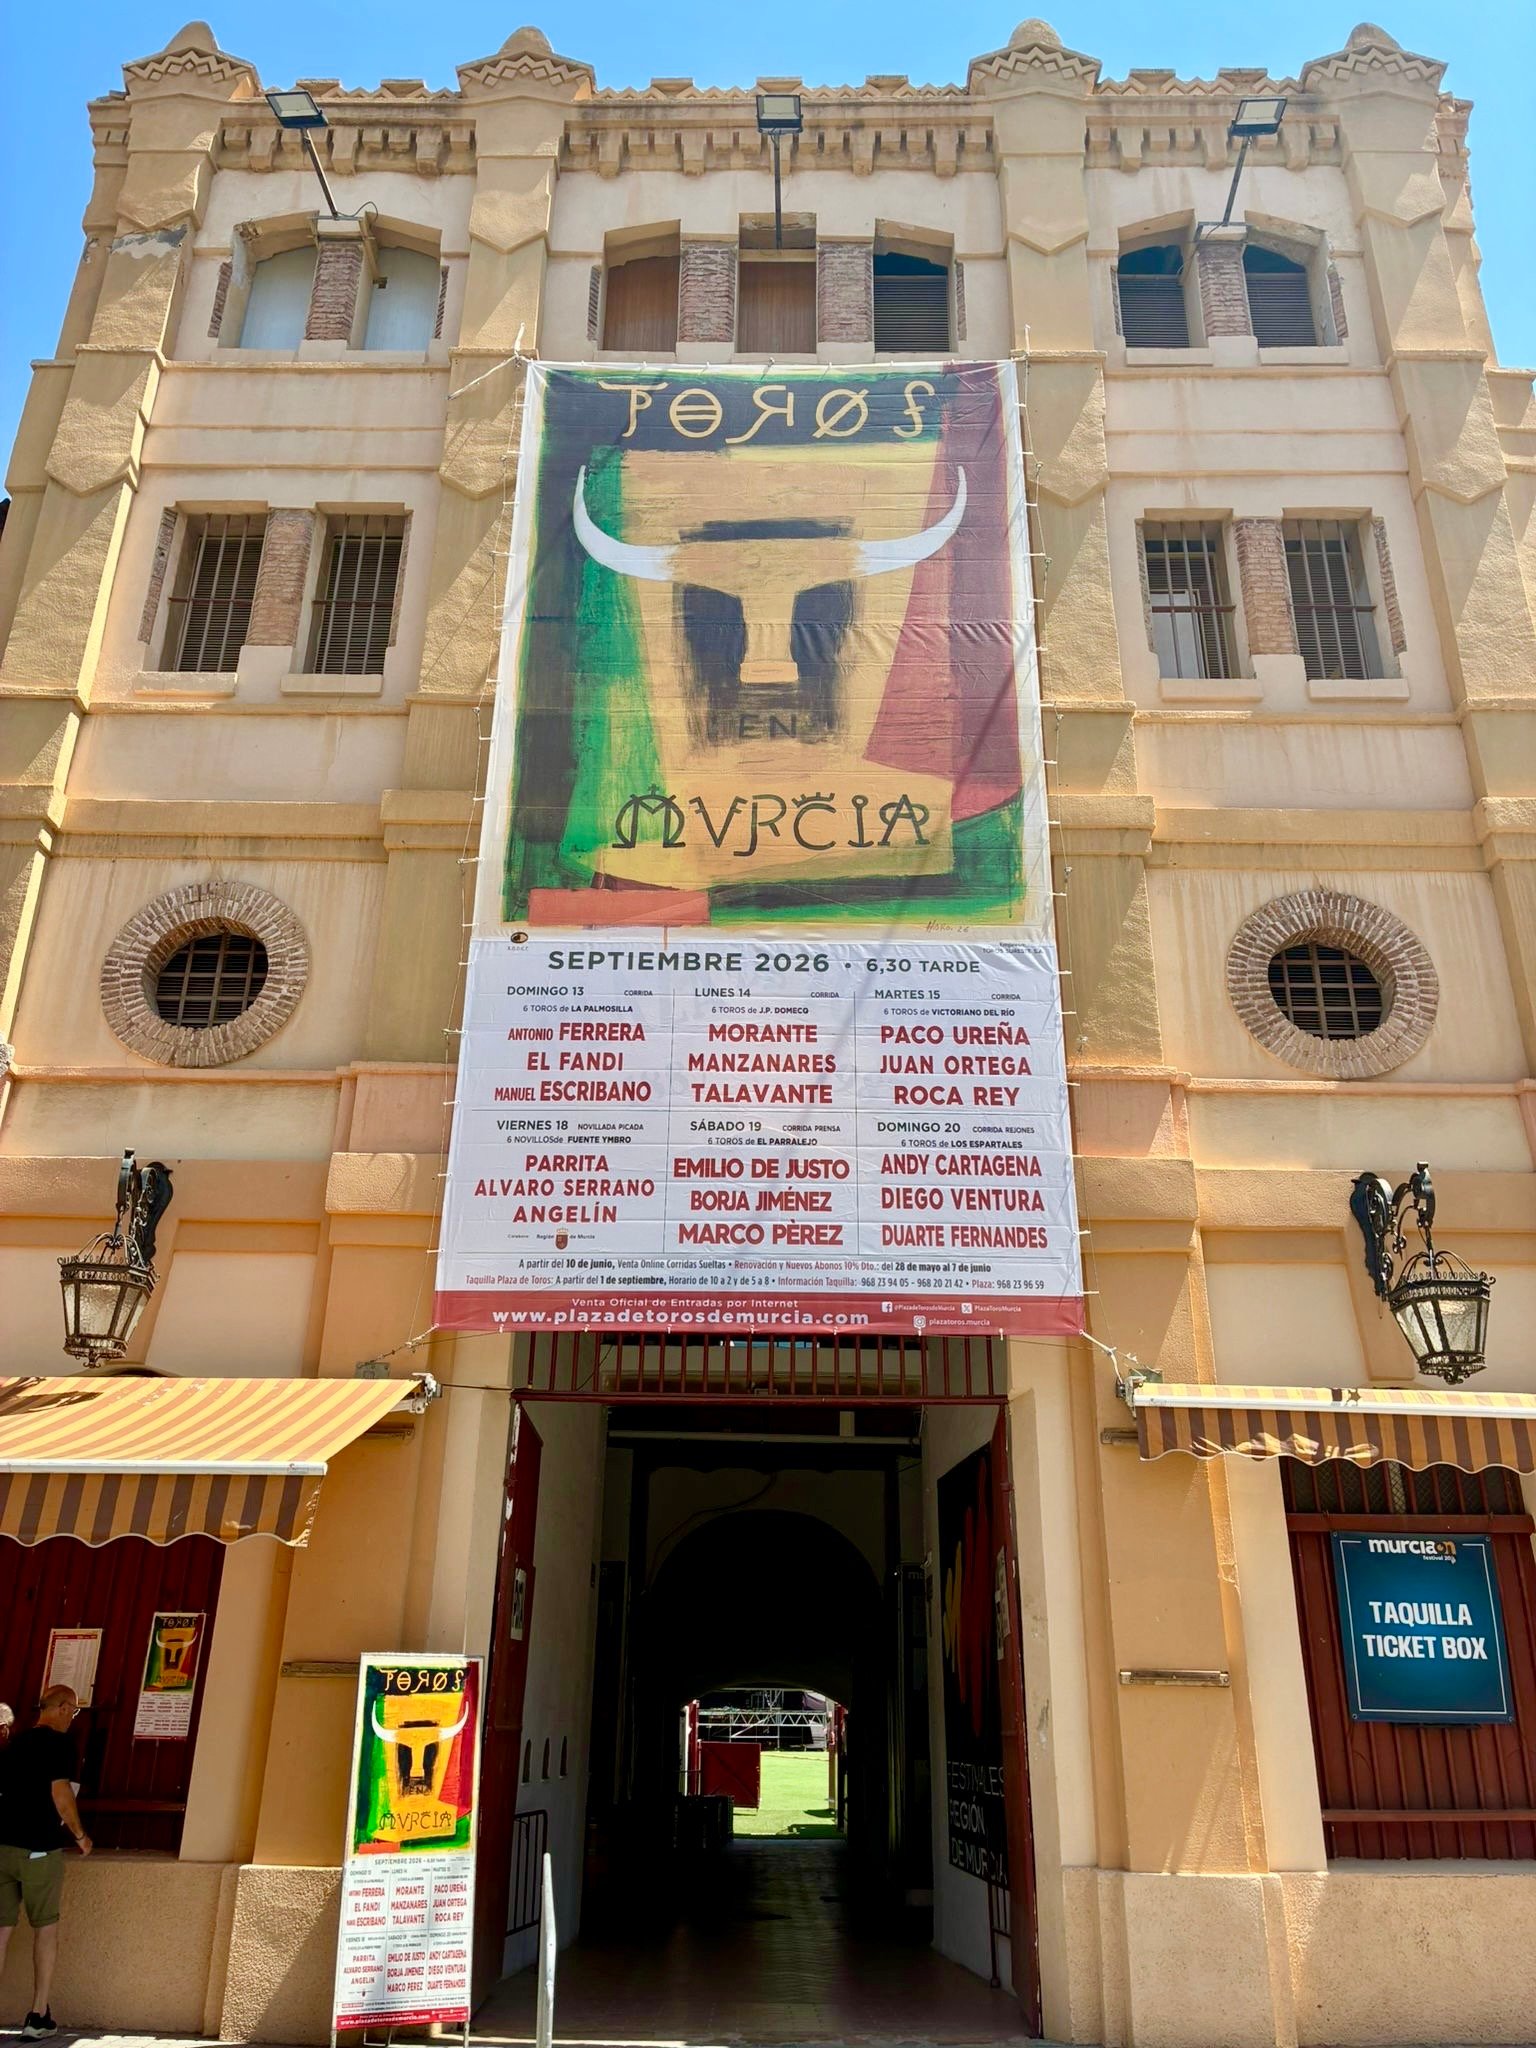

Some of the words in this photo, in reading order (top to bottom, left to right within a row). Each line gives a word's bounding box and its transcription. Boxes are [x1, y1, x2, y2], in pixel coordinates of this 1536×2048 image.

[738, 713, 797, 741] EN
[548, 951, 742, 971] SEPTIEMBRE
[754, 953, 830, 972] 2026
[866, 958, 912, 974] 6,30
[919, 960, 980, 972] TARDE
[507, 986, 569, 996] DOMINGO
[572, 986, 585, 996] 13
[695, 988, 735, 998] LUNES
[739, 988, 751, 998] 14
[874, 990, 924, 999] MARTES
[928, 990, 941, 1000] 15
[584, 1005, 633, 1013] PALMOSILLA
[712, 1006, 716, 1014] 6
[718, 1006, 746, 1014] TOROS
[748, 1006, 758, 1014] de
[883, 1008, 889, 1016] 6
[890, 1008, 918, 1016] TOROS
[920, 1008, 930, 1016] de
[1000, 1008, 1016, 1017] RÍO
[508, 1028, 554, 1041] ANTONIO
[558, 1022, 646, 1041] FERRERA
[708, 1024, 818, 1042] MORANTE
[880, 1025, 944, 1044] PACO
[952, 1021, 1030, 1046] UREÑA
[527, 1052, 550, 1071] EL
[559, 1052, 624, 1071] FANDI
[688, 1053, 836, 1073] MANZANARES
[880, 1055, 934, 1074] JUAN
[944, 1056, 1032, 1076] ORTEGA
[494, 1087, 536, 1101] MANUEL
[540, 1081, 651, 1102] ESCRIBANO
[691, 1083, 833, 1104] TALAVANTE
[894, 1085, 964, 1105] ROCA
[974, 1086, 1020, 1106] REY
[496, 1120, 552, 1130] VIERNES
[556, 1120, 568, 1130] 18
[690, 1118, 745, 1132] SÁBADO
[748, 1122, 762, 1132] 19
[782, 1124, 812, 1132] CORRIDA
[877, 1122, 940, 1132] DOMINGO
[944, 1123, 960, 1133] 20
[972, 1126, 1003, 1134] CORRIDA
[1005, 1126, 1035, 1134] REJONES
[506, 1136, 512, 1144] 6
[568, 1136, 599, 1144] FUENTE
[602, 1136, 632, 1144] YMBRO
[769, 1138, 818, 1146] PARRALEJO
[939, 1140, 949, 1148] de
[951, 1140, 968, 1148] LOS
[526, 1155, 609, 1172] PARRITA
[674, 1158, 745, 1178] EMILIO
[751, 1159, 780, 1178] DE
[785, 1159, 850, 1180] JUSTO
[880, 1154, 930, 1174] ANDY
[935, 1154, 1042, 1176] CARTAGENA
[474, 1179, 554, 1196] ALVARO
[563, 1179, 655, 1196] SERRANO
[690, 1190, 750, 1211] BORJA
[755, 1186, 832, 1212] JIMÉNEZ
[881, 1188, 944, 1210] DIEGO
[951, 1188, 1045, 1211] VENTURA
[512, 1202, 618, 1222] ANGELÍN
[678, 1224, 765, 1244] MARCO
[882, 1224, 944, 1246] DUARTE
[951, 1226, 1048, 1248] FERNANDES
[518, 1260, 524, 1268] A
[526, 1259, 550, 1269] partir
[551, 1259, 564, 1268] del
[566, 1260, 576, 1268] 10
[578, 1259, 588, 1268] de
[590, 1259, 616, 1270] junio,
[617, 1260, 638, 1268] Venta
[640, 1260, 664, 1268] Online
[666, 1260, 697, 1269] Corridas
[698, 1260, 726, 1269] Sueltas
[734, 1260, 778, 1270] Renovación
[786, 1261, 813, 1270] Nuevos
[814, 1262, 842, 1270] Abonos
[844, 1262, 859, 1270] 10%
[861, 1262, 880, 1270] Dto.:
[882, 1262, 894, 1271] del
[895, 1262, 905, 1271] 28
[907, 1262, 917, 1271] de
[918, 1264, 941, 1272] mayo
[942, 1263, 950, 1272] al
[952, 1264, 956, 1272] 7
[958, 1264, 969, 1272] de
[970, 1264, 991, 1273] junio
[466, 1275, 495, 1285] Taquilla
[497, 1275, 518, 1284] Plaza
[520, 1275, 528, 1284] de
[556, 1276, 561, 1284] A
[562, 1276, 584, 1286] partir
[586, 1276, 598, 1284] del
[600, 1276, 604, 1284] 1
[606, 1276, 616, 1284] de
[618, 1276, 666, 1286] septiembre,
[572, 1298, 606, 1306] Venta
[610, 1298, 648, 1306] Oficial
[652, 1299, 666, 1307] de
[670, 1299, 722, 1307] Entradas
[726, 1300, 748, 1309] por
[751, 1300, 798, 1308] Internet
[492, 1310, 868, 1325] www.plazadetorosdemurcia.com
[1369, 1602, 1472, 1627] TAQUILLA
[1362, 1634, 1436, 1658] TICKET
[1442, 1636, 1488, 1660] BOX
[396, 1886, 424, 1895] MORANTE
